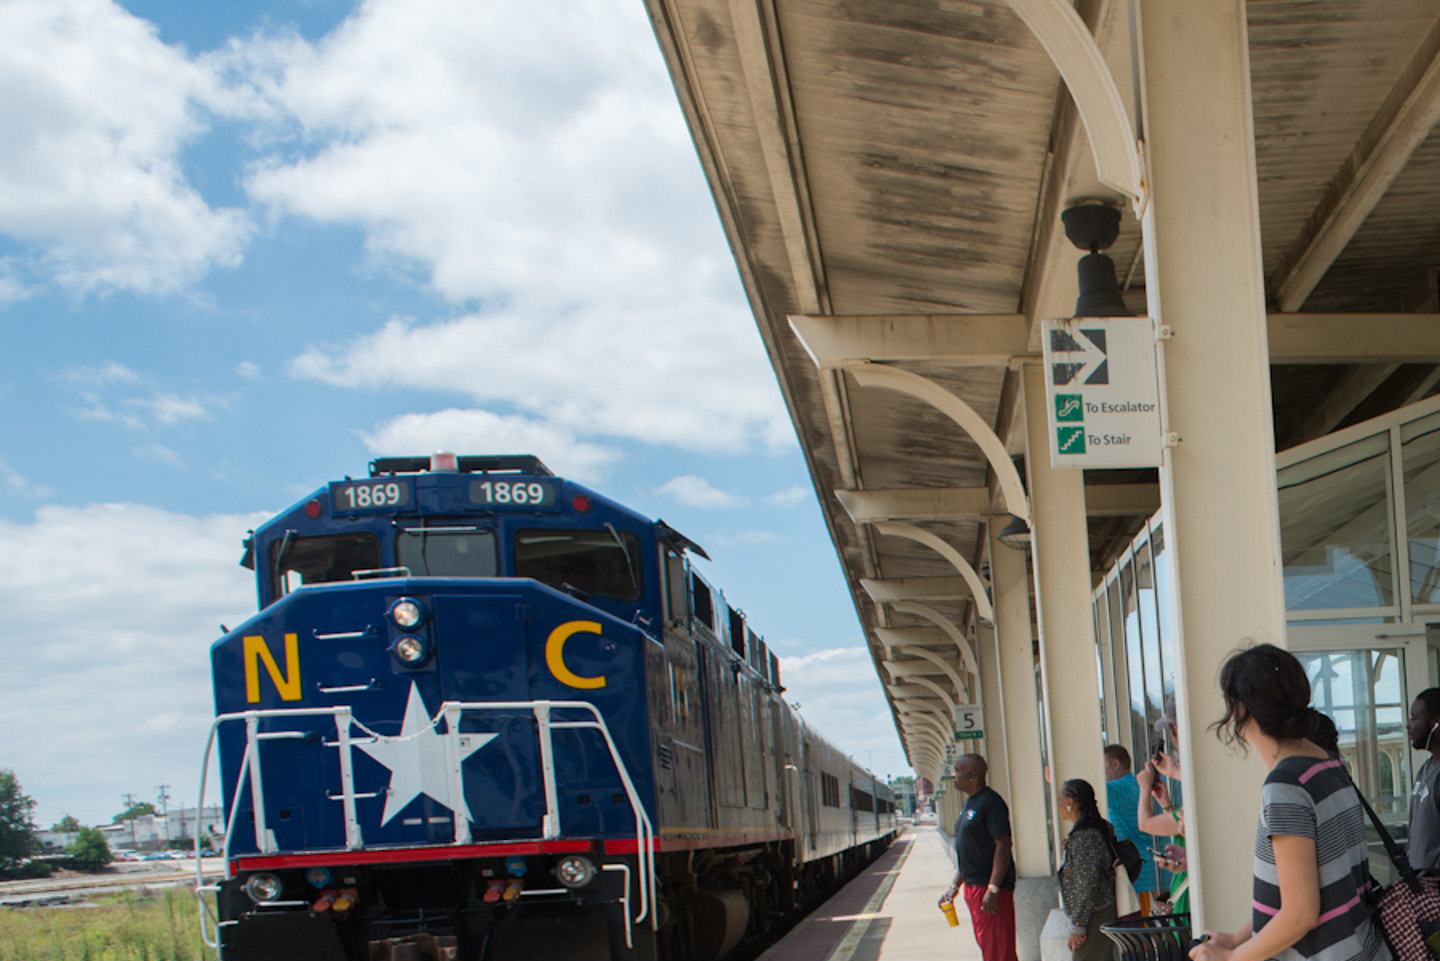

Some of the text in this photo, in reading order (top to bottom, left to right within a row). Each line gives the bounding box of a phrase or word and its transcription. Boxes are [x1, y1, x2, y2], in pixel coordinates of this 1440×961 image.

[1085, 401, 1155, 413] To Escalator
[1087, 433, 1131, 445] To Stair
[344, 483, 400, 508] 1869
[480, 481, 544, 504] 1869
[242, 620, 607, 703] N C
[963, 713, 975, 729] 5
